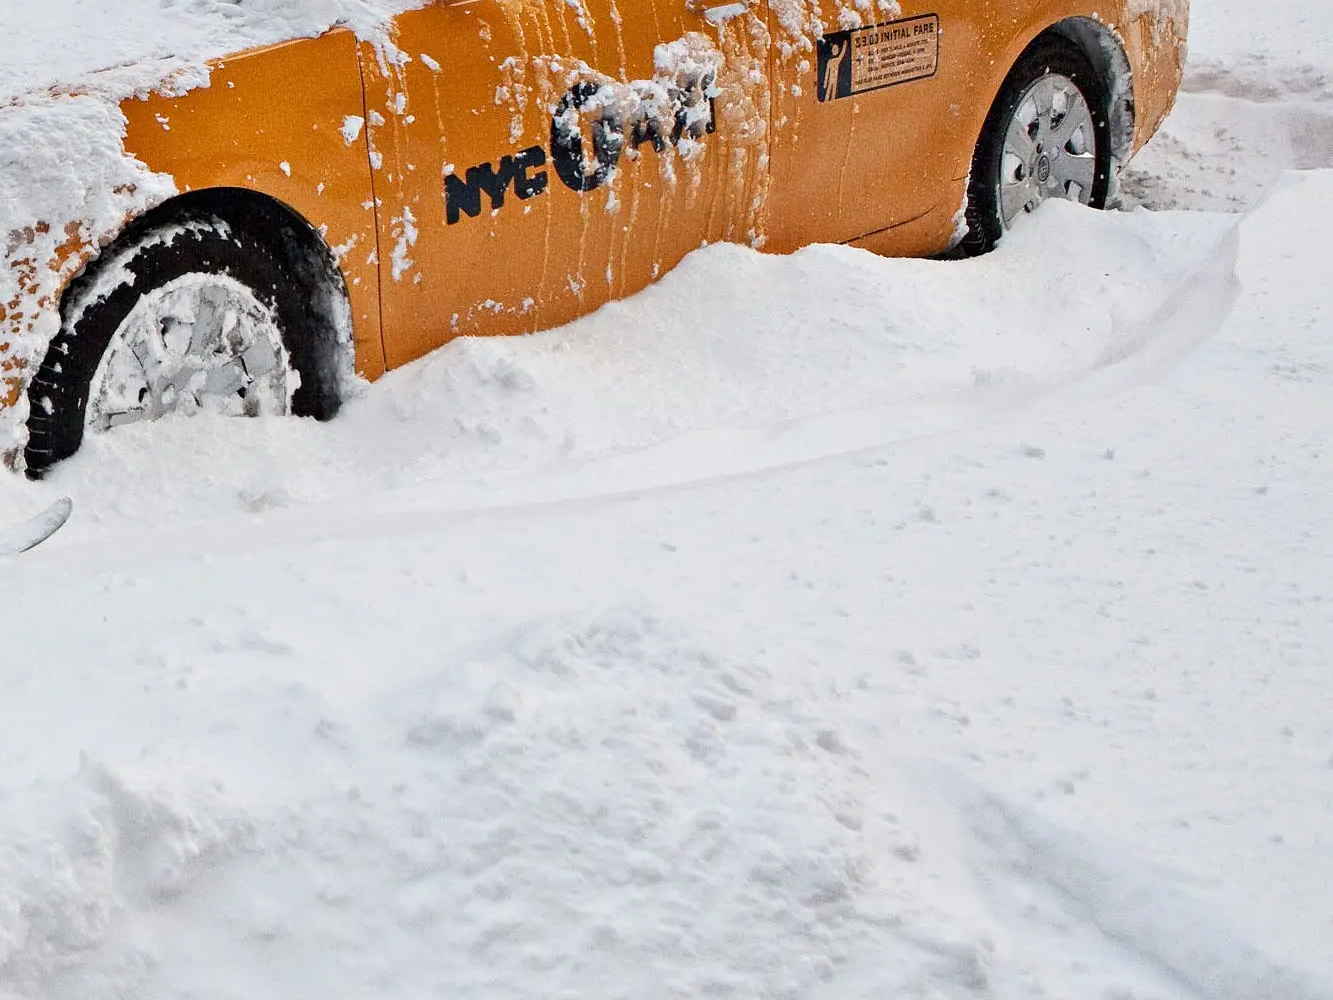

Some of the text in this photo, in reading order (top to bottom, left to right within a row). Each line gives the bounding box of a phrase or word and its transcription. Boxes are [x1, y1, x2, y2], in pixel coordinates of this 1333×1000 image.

[880, 28, 911, 43] INITIAL
[913, 22, 934, 36] FARE
[444, 145, 548, 225] NYC
